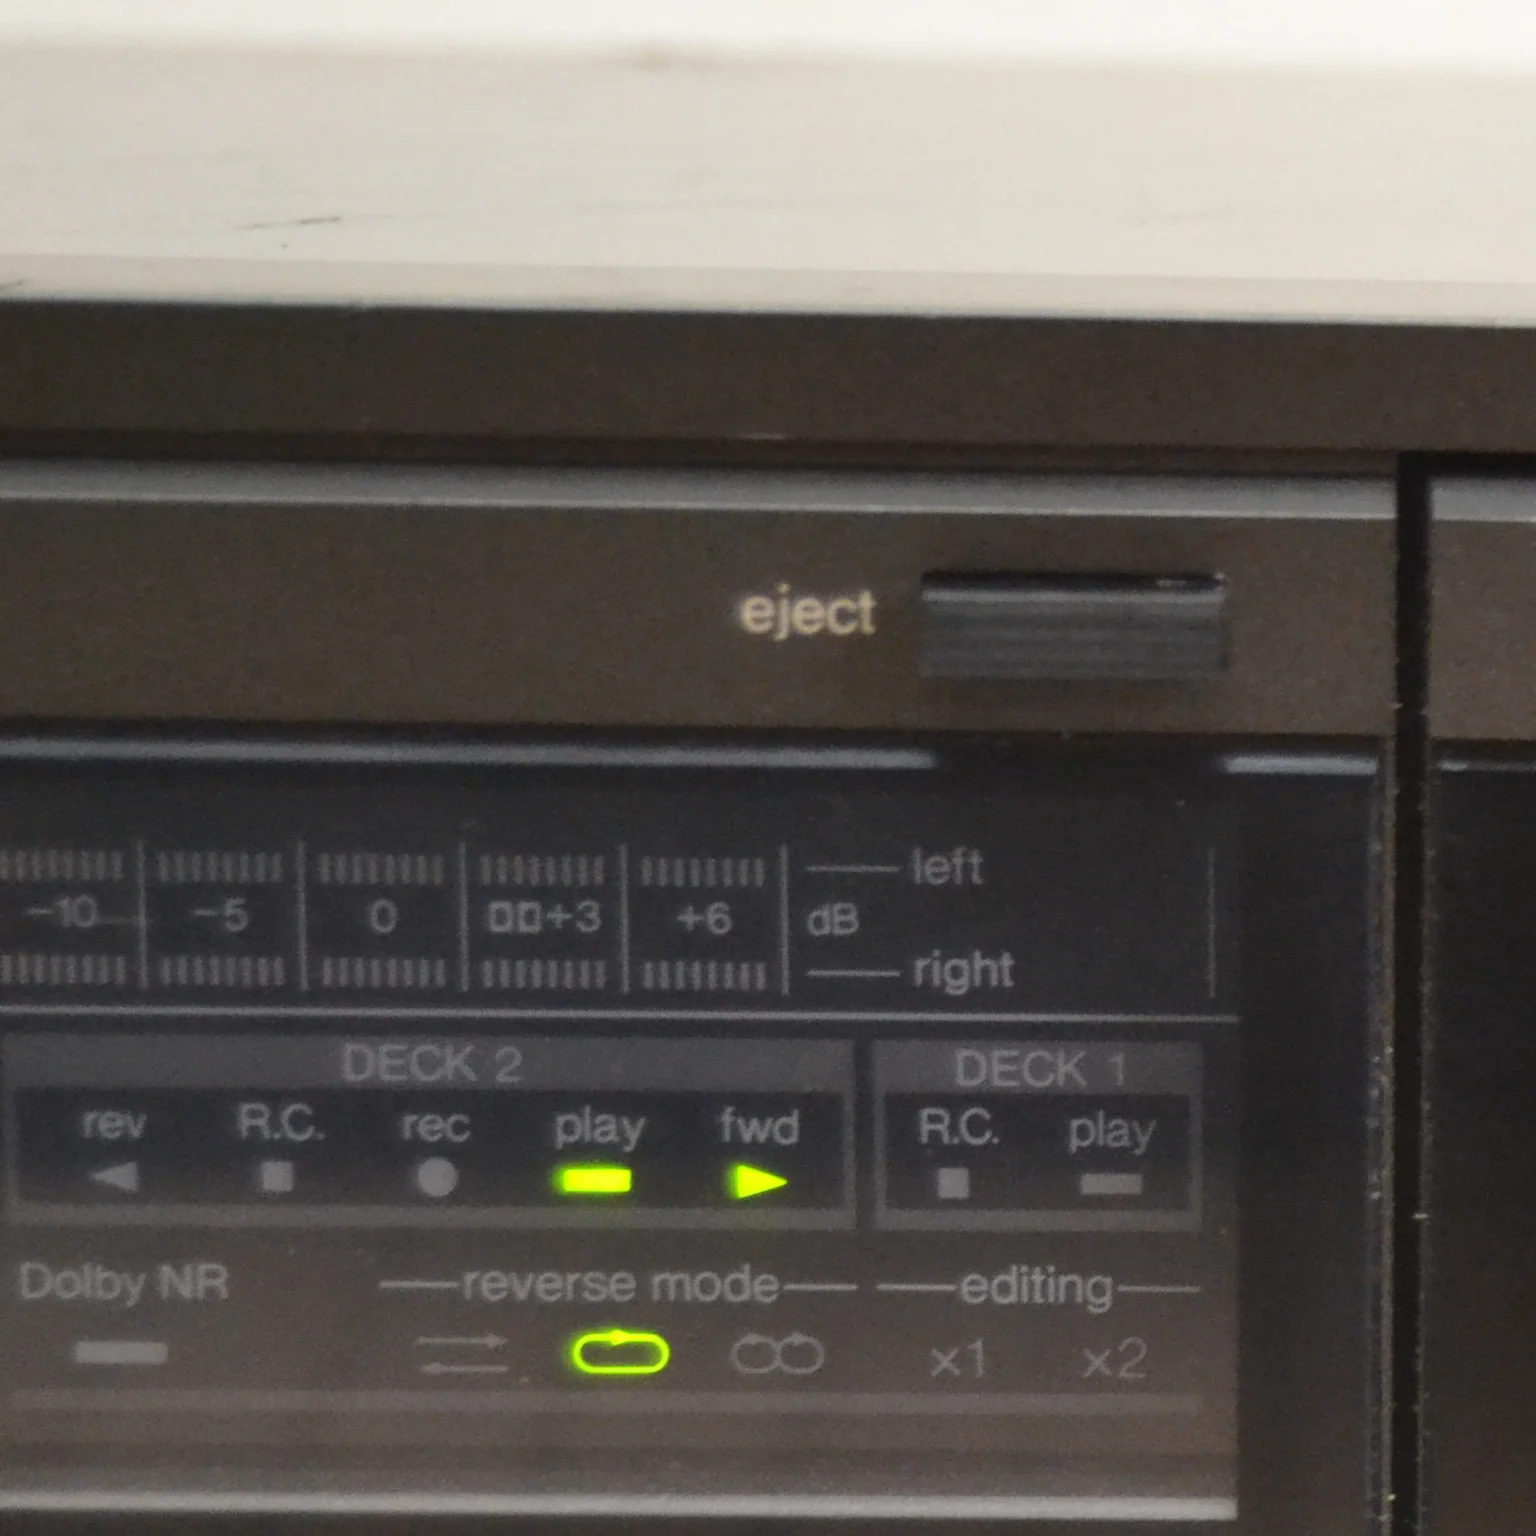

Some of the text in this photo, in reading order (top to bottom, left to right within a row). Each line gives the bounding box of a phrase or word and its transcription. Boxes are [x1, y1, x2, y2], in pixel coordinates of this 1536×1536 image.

[738, 583, 877, 641] eject
[912, 847, 984, 886] left
[371, 899, 397, 934] 0
[677, 902, 733, 936] +6
[807, 902, 860, 936] dB
[912, 950, 1015, 996] right
[340, 1043, 524, 1083] DECK 2
[955, 1048, 1127, 1088] DECK 1
[81, 1110, 147, 1140] rev
[237, 1102, 326, 1143] R.C.
[401, 1111, 472, 1143] rec
[553, 1105, 646, 1152] play
[719, 1107, 800, 1145] fwd
[918, 1107, 1000, 1146] R.C.
[1069, 1110, 1157, 1156] play
[18, 1261, 229, 1305] Dolby NR
[462, 1263, 780, 1302] reverse mode
[960, 1265, 1114, 1314] editing
